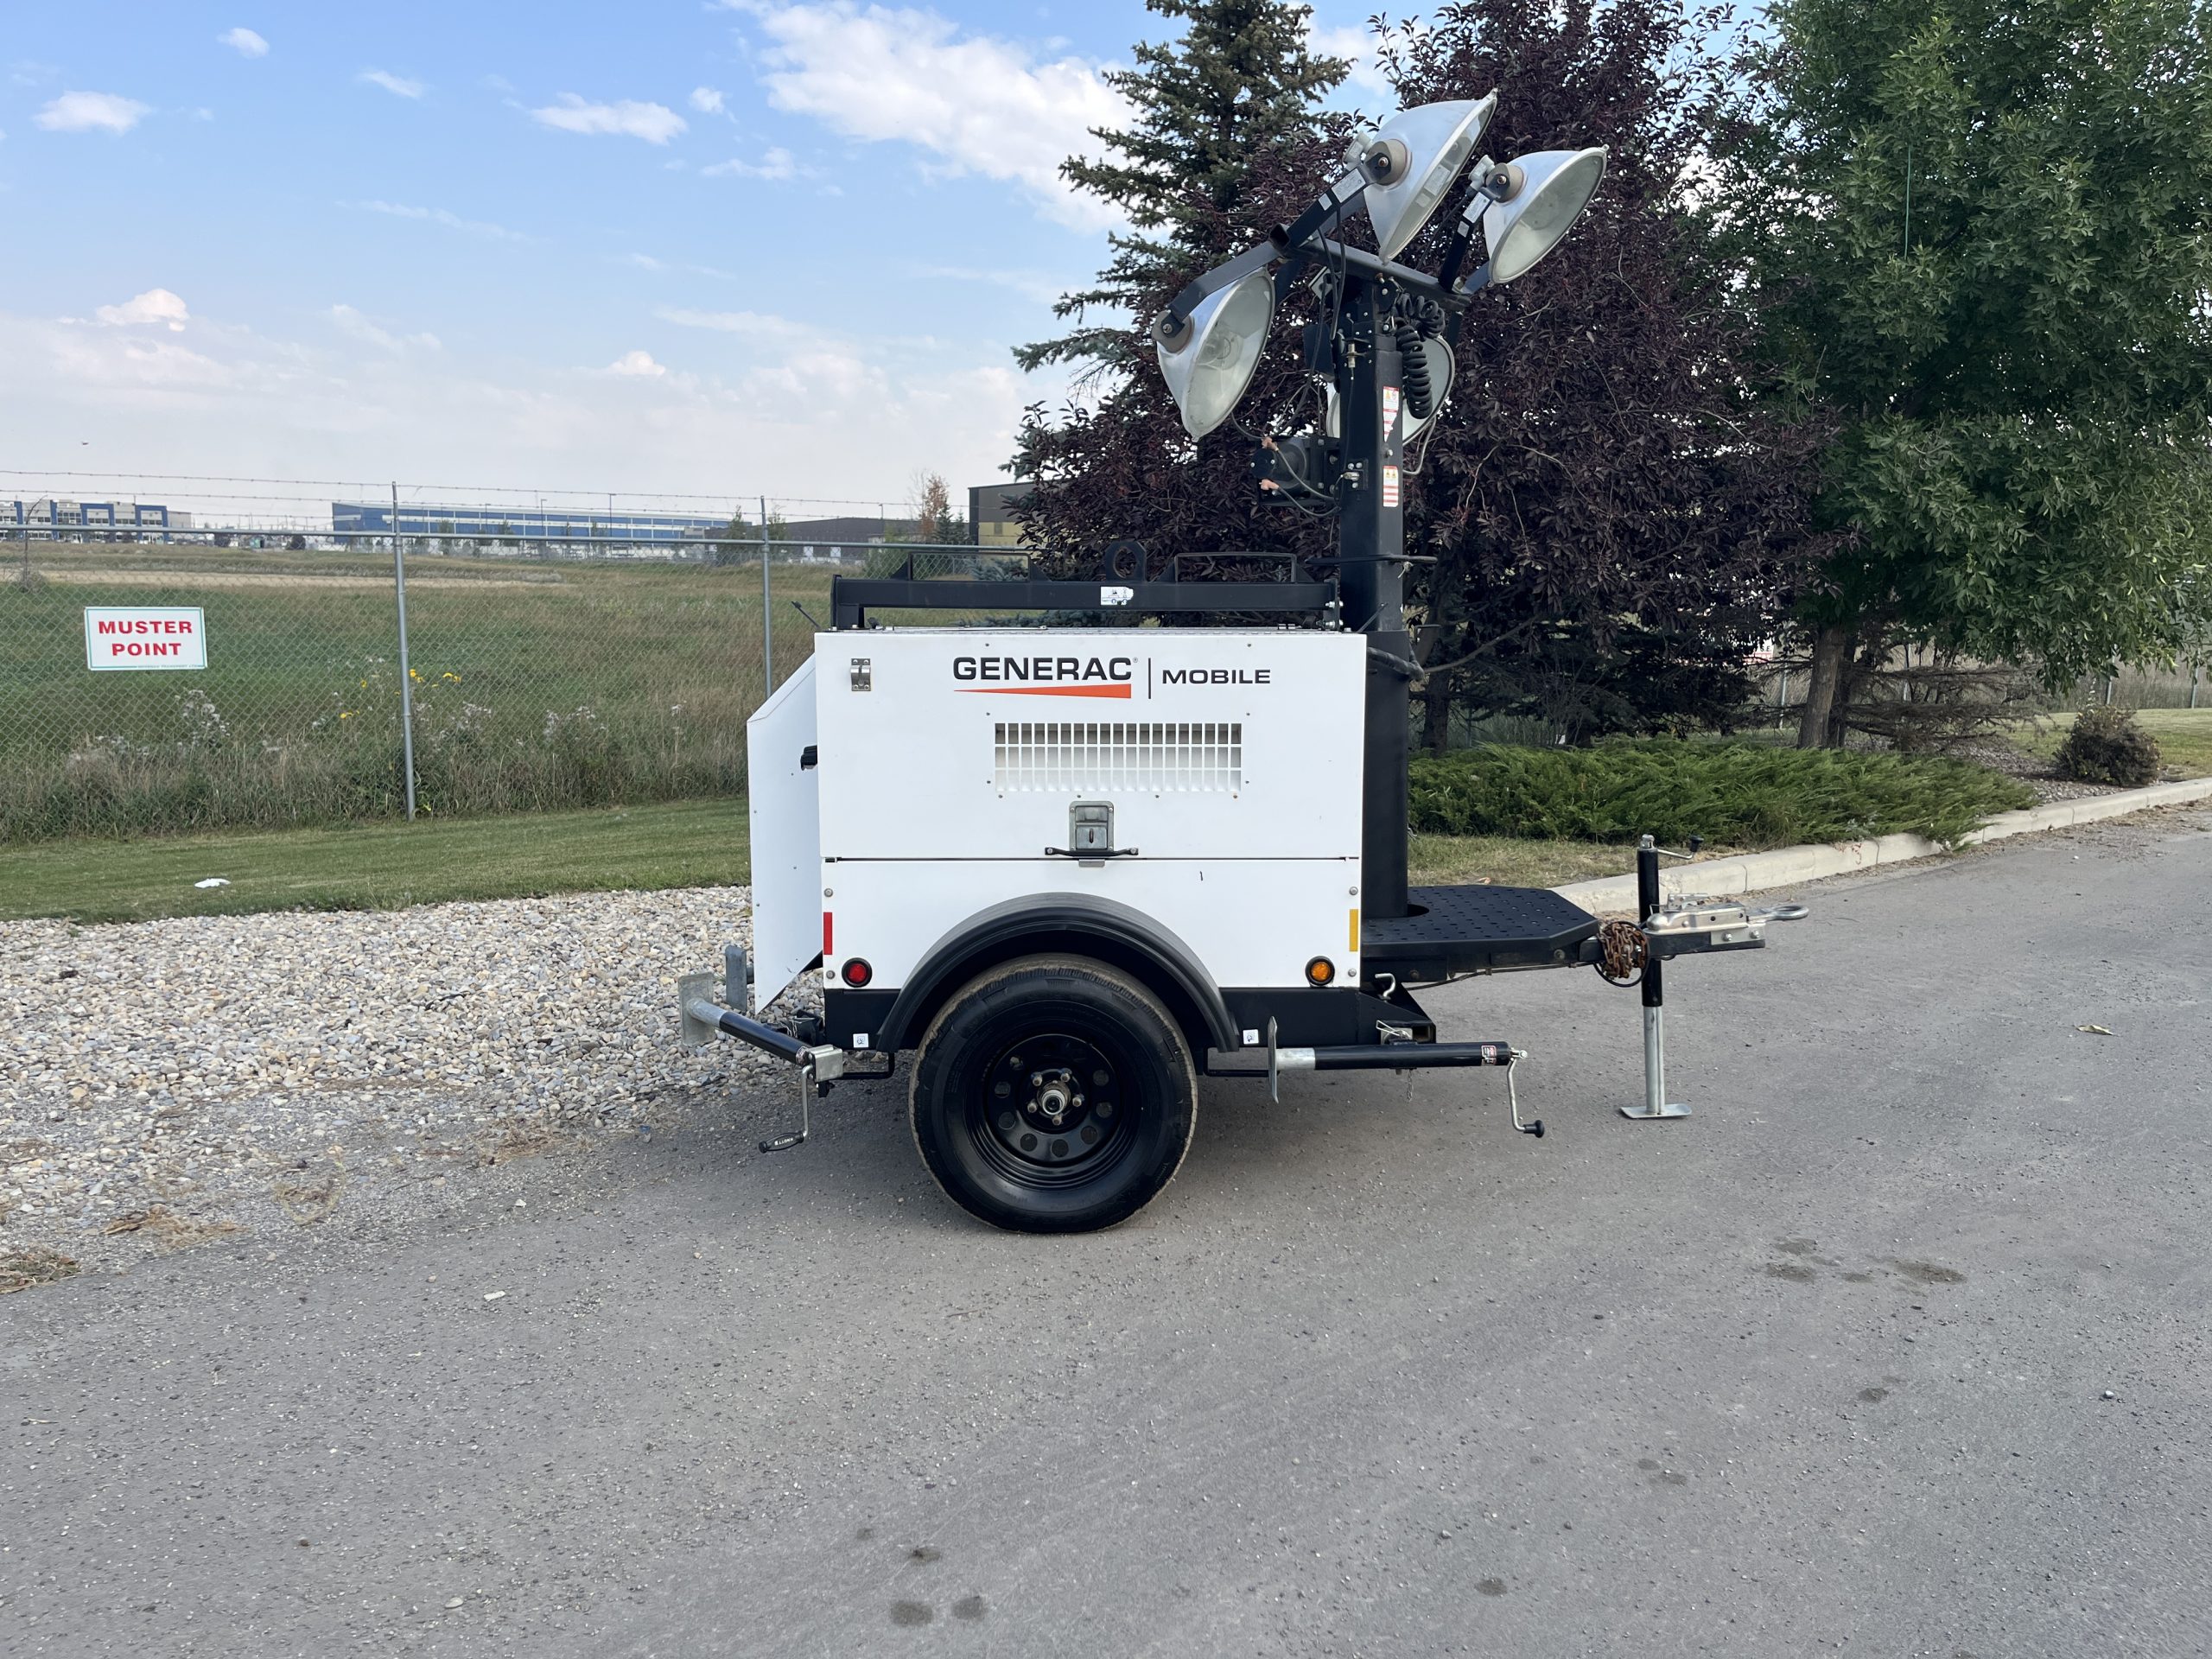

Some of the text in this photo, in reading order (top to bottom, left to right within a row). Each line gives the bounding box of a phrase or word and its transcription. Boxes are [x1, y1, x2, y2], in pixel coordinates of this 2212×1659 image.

[99, 620, 193, 634] MUSTER
[111, 642, 181, 657] POINT
[953, 657, 1271, 684] GENERAC MOBILE
